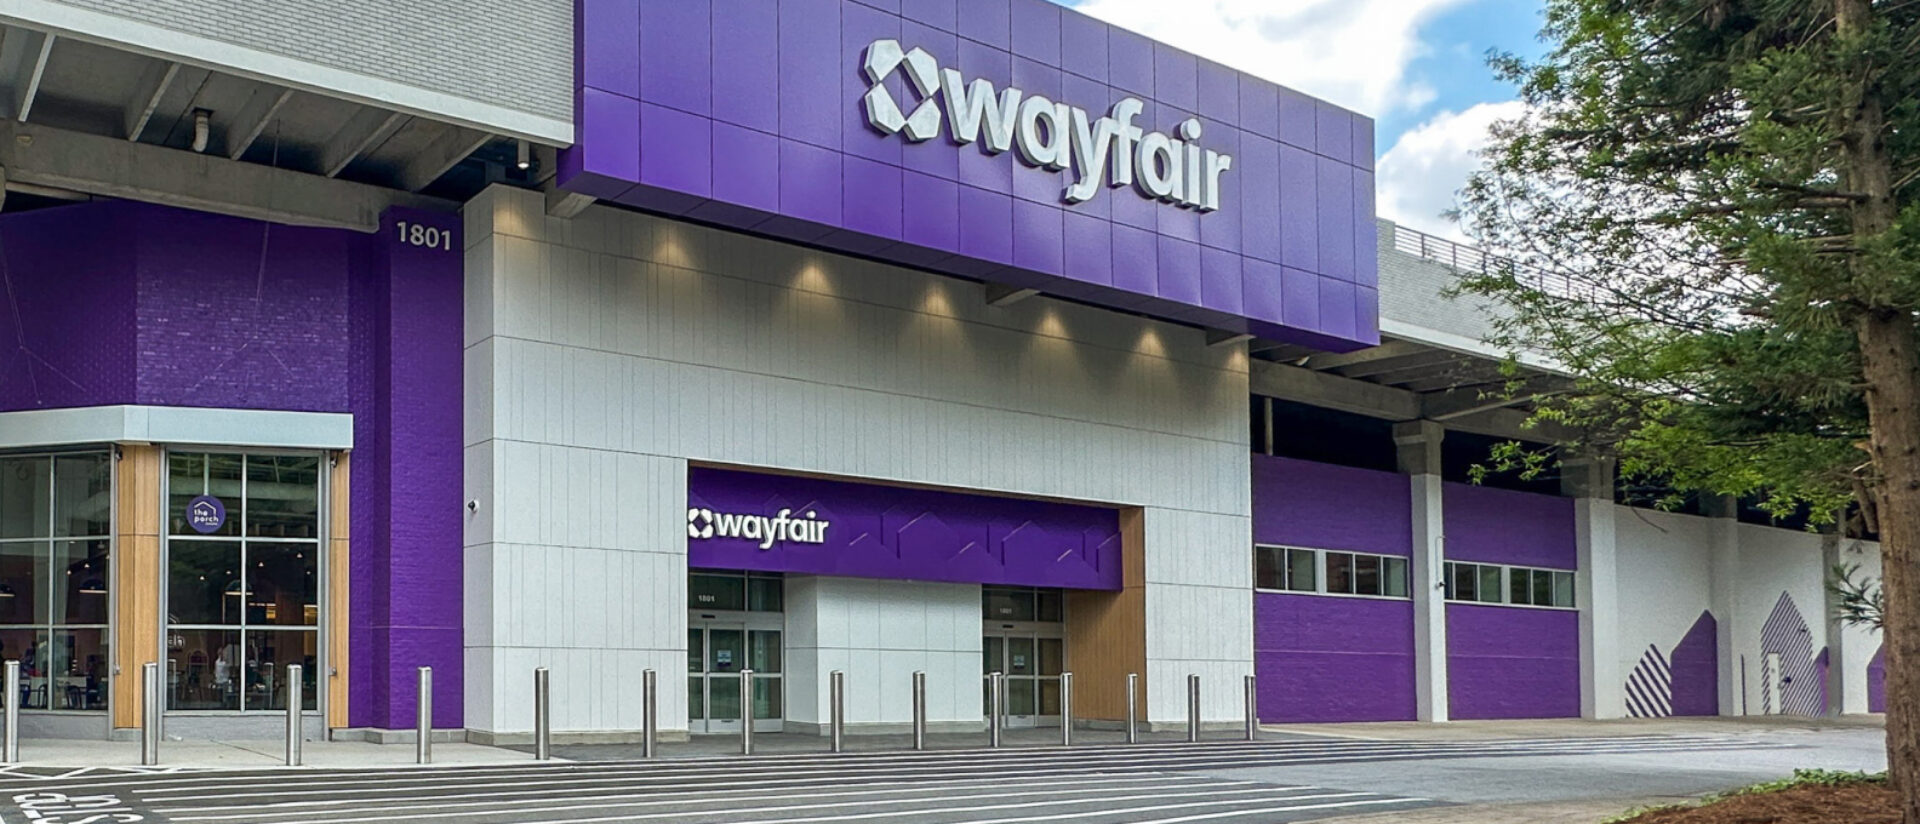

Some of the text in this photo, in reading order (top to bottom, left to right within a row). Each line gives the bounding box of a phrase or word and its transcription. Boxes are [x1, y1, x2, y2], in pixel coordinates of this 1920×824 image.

[939, 67, 1231, 213] wayfair
[397, 221, 450, 251] 1801
[713, 508, 829, 549] wayfair
